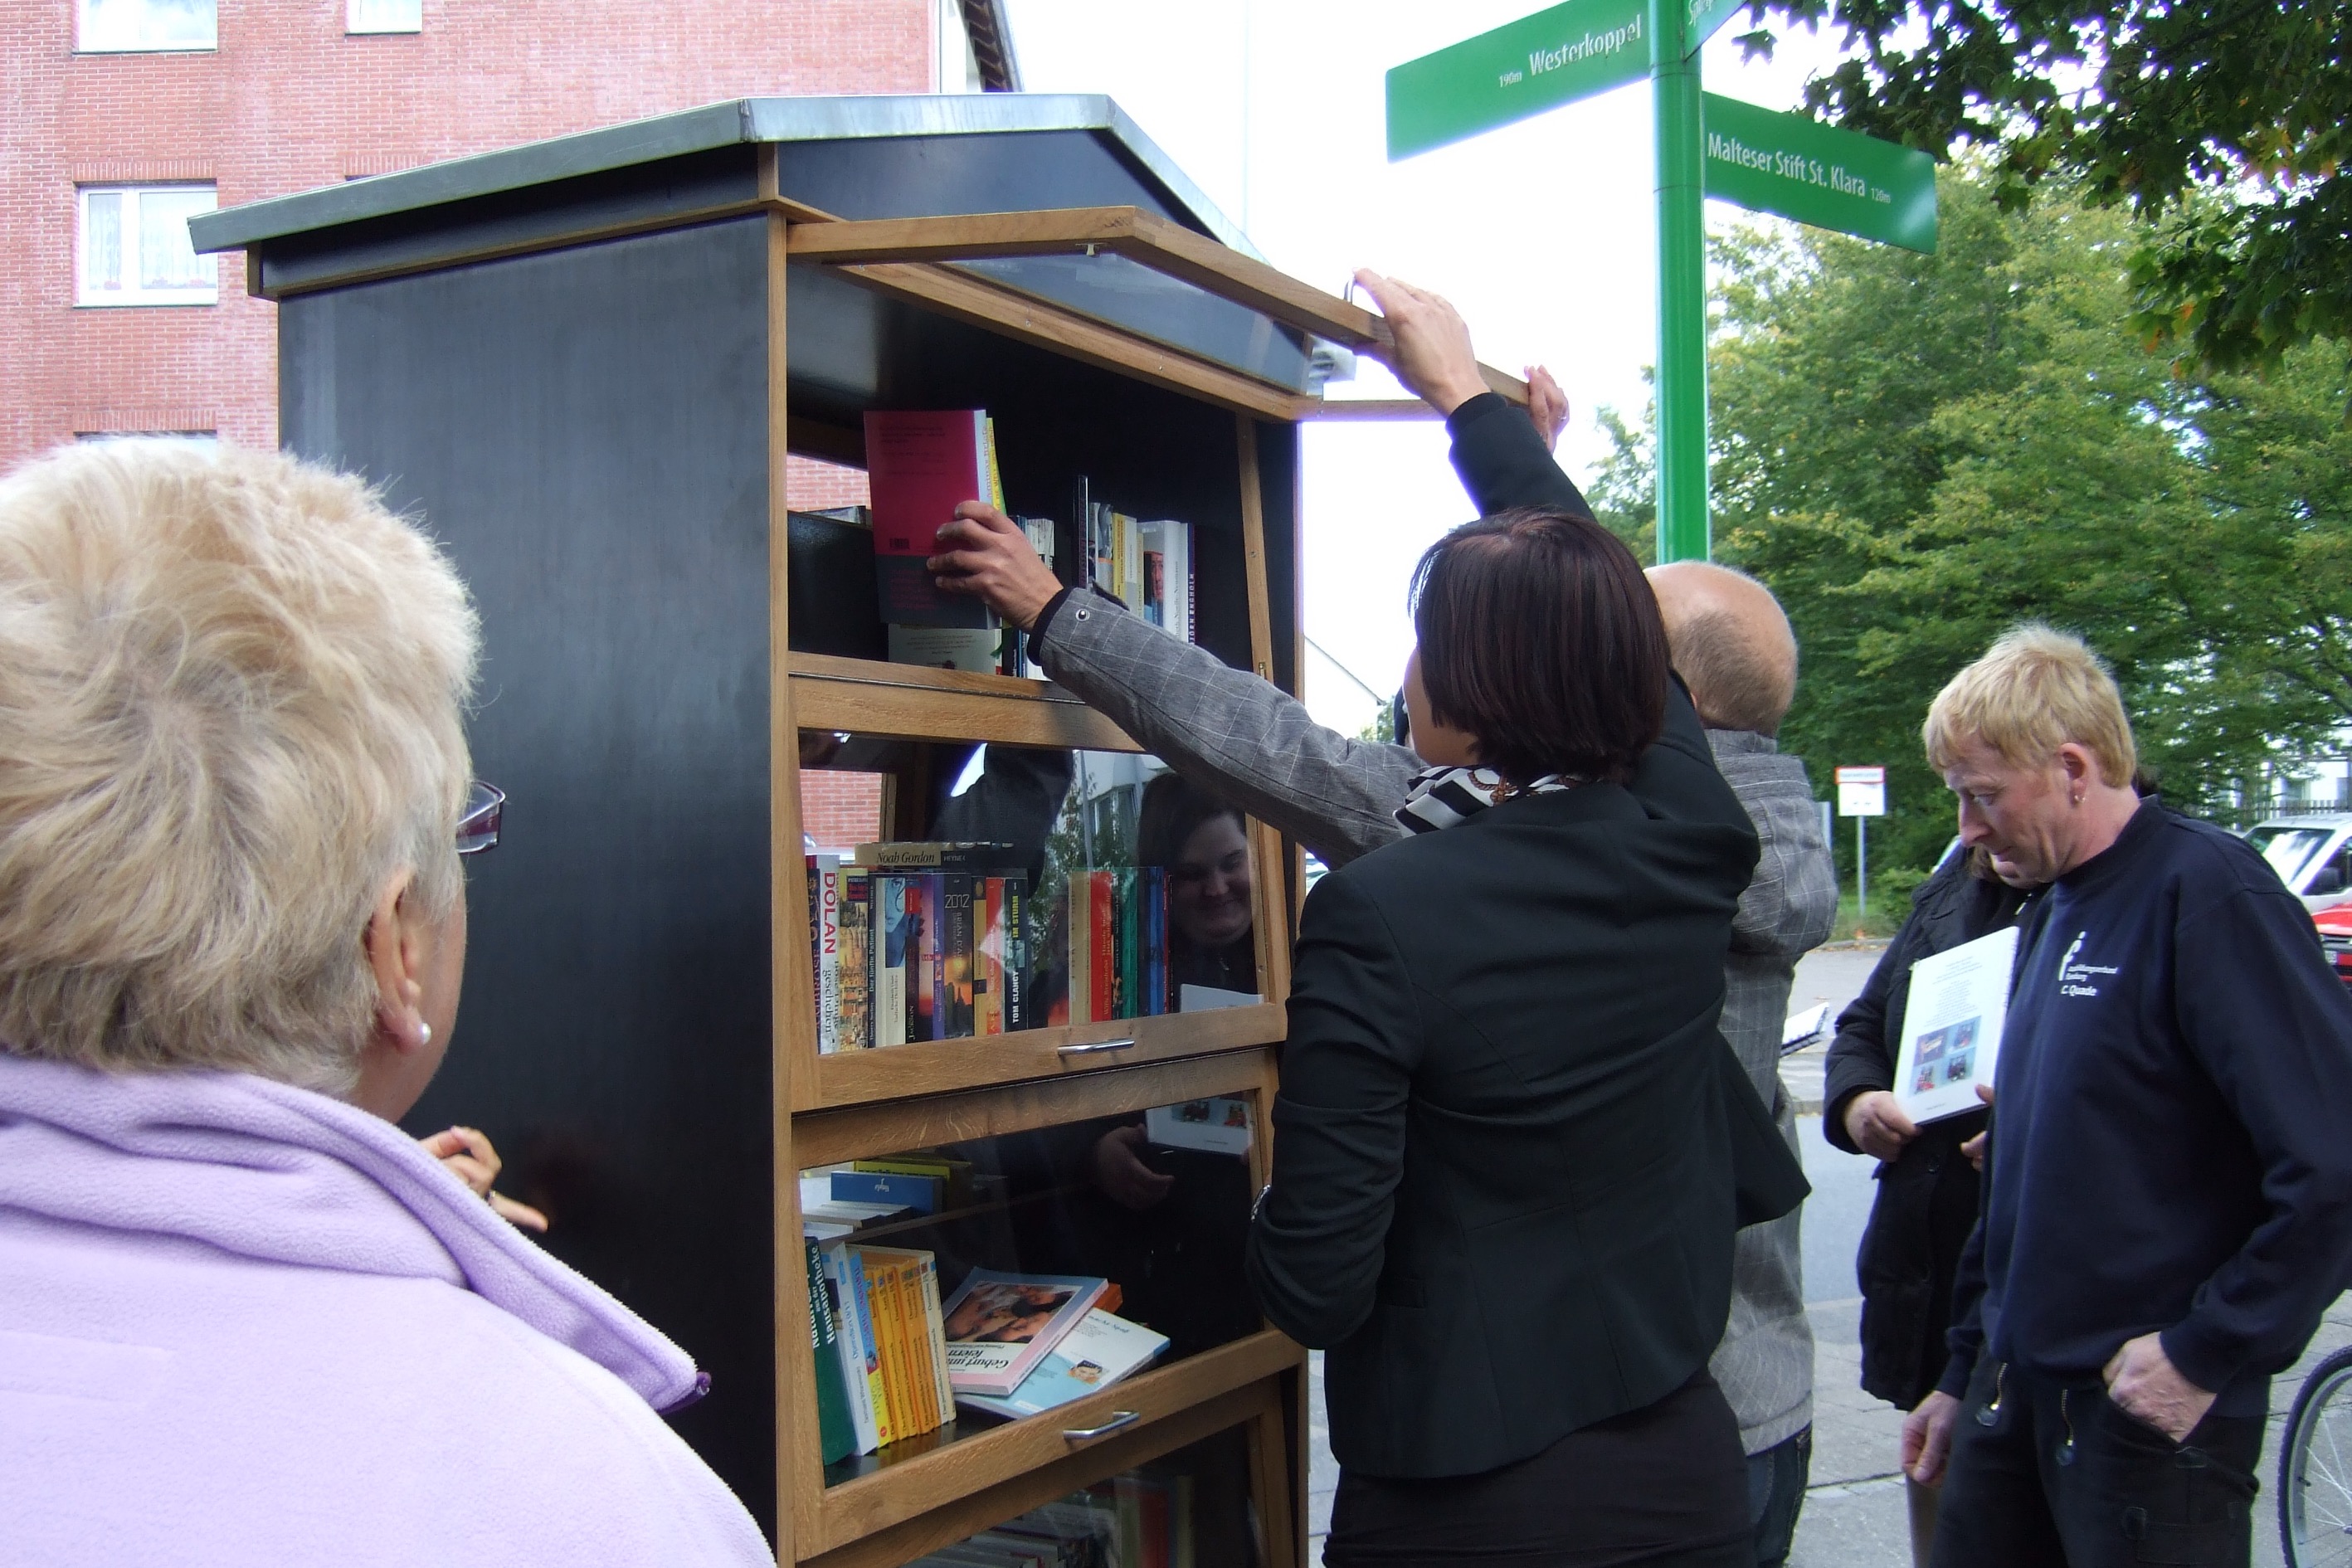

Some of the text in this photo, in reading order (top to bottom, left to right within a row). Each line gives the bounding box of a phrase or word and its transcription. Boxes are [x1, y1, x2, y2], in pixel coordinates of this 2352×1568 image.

[1498, 70, 1523, 88] 190m
[1528, 13, 1642, 76] Westerkoppel
[1707, 131, 1892, 204] Malteser Stift St. Klara 120m
[877, 850, 935, 864] Noah Gordon
[945, 893, 970, 909] 2012
[824, 872, 836, 954] DOLAN
[1011, 926, 1019, 937] IM
[2069, 984, 2097, 997] Quade
[822, 969, 835, 1034] geschehen
[811, 1245, 835, 1344] Hausapotheke
[812, 1286, 821, 1298] der
[847, 1322, 859, 1359] Operation
[947, 1350, 984, 1359] feiern
[965, 1356, 1009, 1369] Geburt
